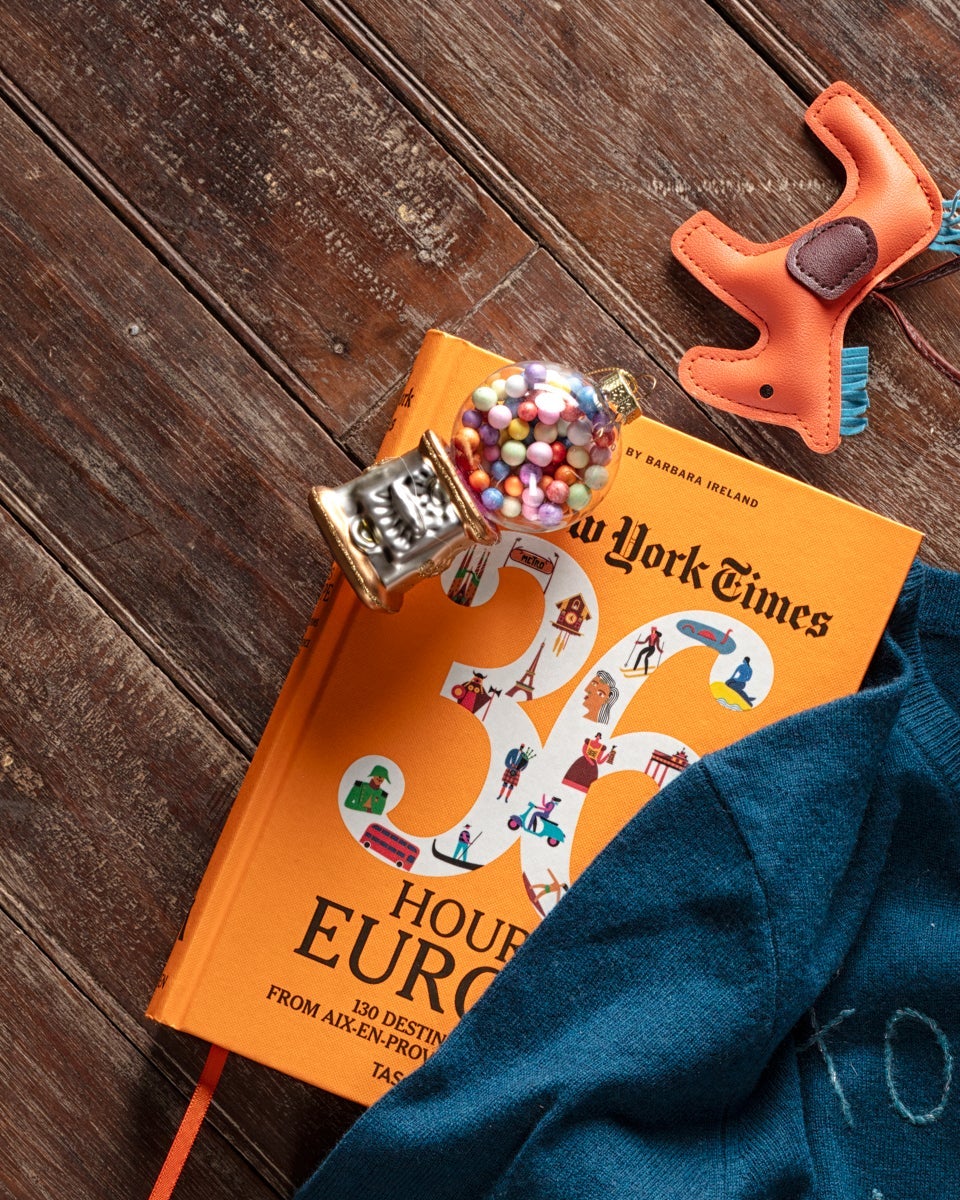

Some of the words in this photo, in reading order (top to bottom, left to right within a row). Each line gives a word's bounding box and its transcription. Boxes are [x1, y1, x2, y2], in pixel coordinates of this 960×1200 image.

[626, 447, 642, 459] BY
[645, 455, 702, 486] BARBARA
[707, 480, 759, 508] IRELAND
[522, 554, 545, 570] METRO
[604, 516, 710, 589] York
[711, 557, 834, 638] Times
[266, 984, 321, 1018] FROM
[352, 999, 380, 1020] 130
